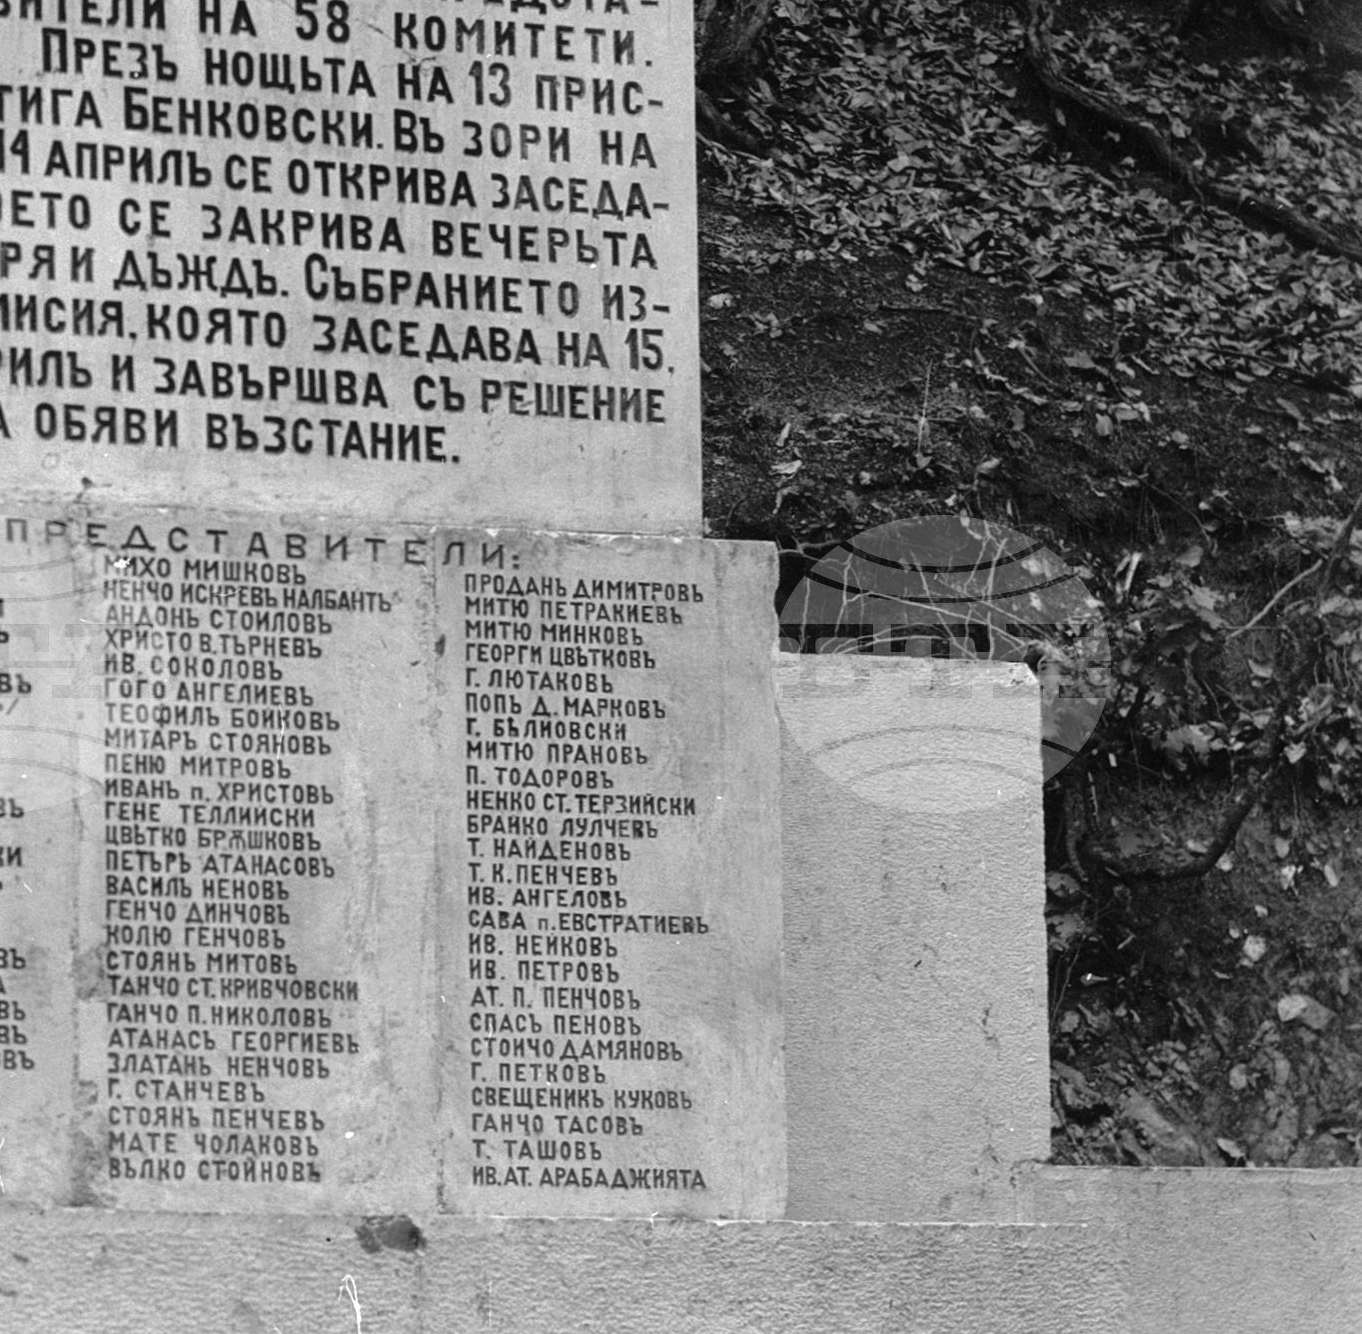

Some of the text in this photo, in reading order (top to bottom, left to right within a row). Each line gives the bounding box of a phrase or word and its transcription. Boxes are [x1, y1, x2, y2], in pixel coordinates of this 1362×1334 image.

[395, 12, 652, 67] КОМИТЕТИ.
[42, 27, 663, 116] ПРЕЗЪ НОЩЬТА НА 13 ПРИС-
[124, 86, 383, 149] БЕНКОВСКИ.
[394, 108, 445, 153] ВЪ
[463, 121, 571, 163] ЗОРИ
[600, 130, 657, 169] НА
[44, 140, 212, 188] АПРИЛЪ
[225, 154, 272, 194] СЕ
[288, 158, 477, 208] ОТКРИВА
[491, 173, 669, 221] ЗАСЕДА-
[119, 198, 172, 238] СЕ
[201, 204, 406, 253] ЗАКРИВА
[432, 220, 658, 270] ВЕЧЕРЬТА
[70, 246, 95, 283] И
[114, 250, 289, 299] ДЪЖДЪ.
[305, 253, 579, 318] СЪБРАНИЕТО
[602, 283, 671, 322] ИЗ-
[146, 302, 287, 348] КОЯТО
[312, 314, 542, 366] ЗАСЕДАВА
[558, 331, 609, 369] НА
[112, 354, 136, 392] И
[153, 357, 389, 409] ЗАВЪРШВА
[414, 375, 465, 413] СЪ
[481, 378, 666, 423] РЕШЕНИЕ
[34, 403, 179, 447] ОБЯВИ
[206, 412, 461, 464] ВЪЗСТАНИЕ.
[6, 518, 520, 569] ПРЕДСТАВИТЕЛИ:
[104, 579, 392, 612] НЕНЧО ИСКРЕВЪ НАЛБАНТЪ
[465, 574, 704, 603] ПРОДАНЪ ДИМИТРОВЪ
[465, 597, 683, 625] МИТЮ ПЕТРАКИЕВЪ
[465, 620, 643, 647] МИТЮ МИНКОВЪ
[105, 678, 314, 707] ГОГО АНГЕЛИЕВЪ
[105, 728, 332, 756] МИТАРЪ СТОЯНОВЪ
[466, 741, 649, 765] МИТЮ ПРАНОВЪ
[105, 755, 292, 779] ПЕНЮ МИТРОВЪ
[106, 851, 336, 879] ПЕТЪРЪ АТАНАСОВЪ
[106, 900, 290, 926] ГЕНЧО ДИНЧОВЪ
[106, 925, 286, 950] КОЛЮ ГЕНЧОВЪ
[106, 951, 298, 975] СТОЯНЪ МИТОВЪ
[470, 1012, 642, 1036] СПАСЪ ПЕНОВЪ
[107, 1028, 360, 1055] АТАНАСЪ ГЕОРГИЕВЪ
[107, 1052, 330, 1079] ЗЛАТАНЪ НЕНЧОВЪ
[471, 1087, 693, 1110] СВЕЩЕНИКЪ КУКОВЪ
[108, 1106, 326, 1132] СТОЯНЪ ПЕНЧЕВЪ
[471, 1113, 643, 1137] ГАНЧО ТАСОВЪ
[108, 1131, 320, 1157] МАТЕ ЧОЛАКОВЪ
